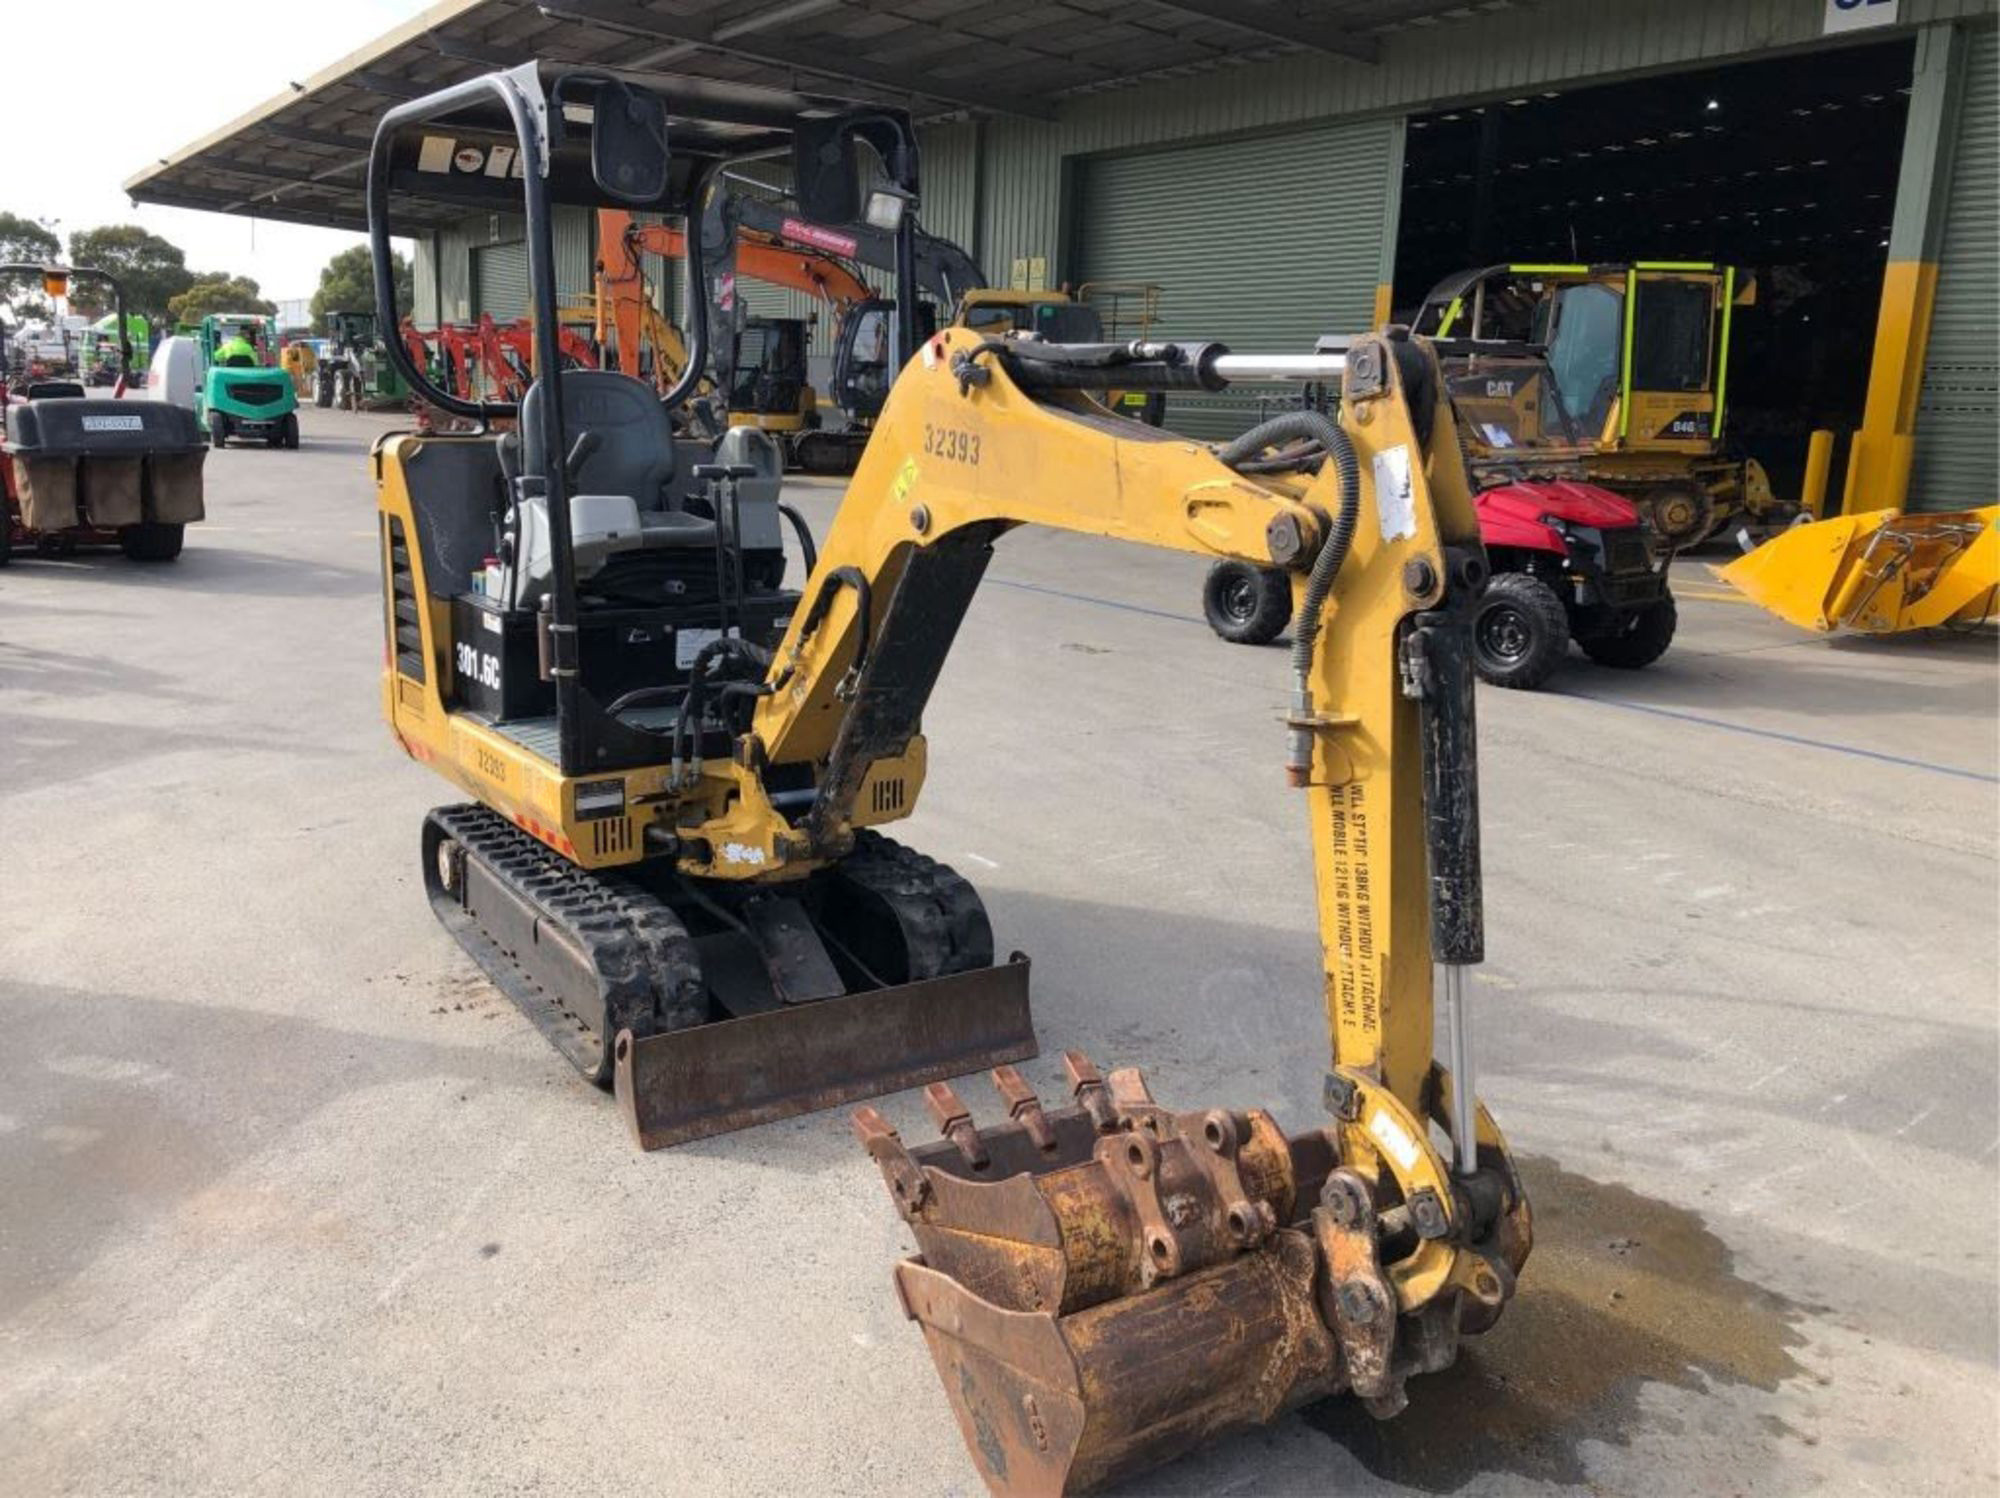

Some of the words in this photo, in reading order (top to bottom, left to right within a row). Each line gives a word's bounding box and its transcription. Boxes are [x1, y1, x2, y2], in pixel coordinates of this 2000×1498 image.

[1487, 381, 1513, 397] CAT
[925, 424, 980, 465] 32393
[457, 642, 500, 690] 301.6C
